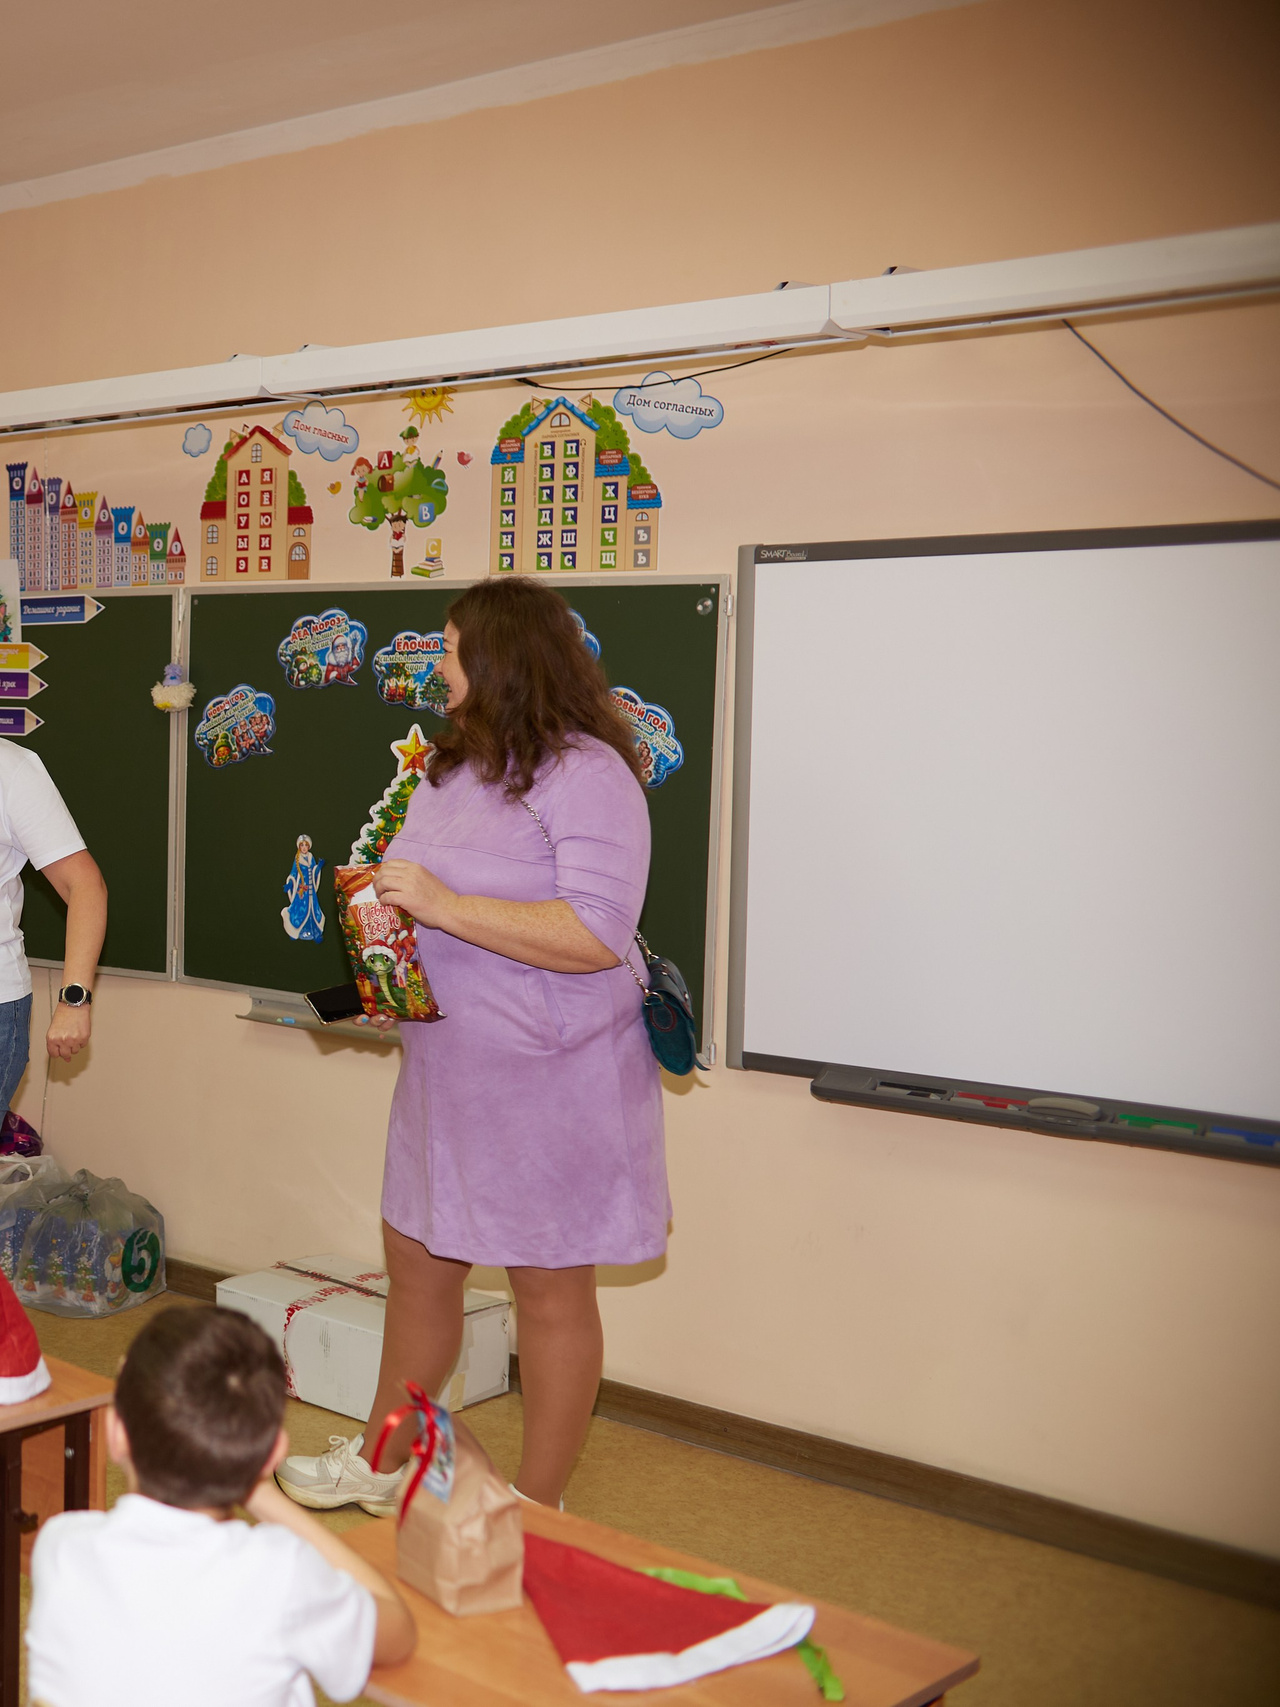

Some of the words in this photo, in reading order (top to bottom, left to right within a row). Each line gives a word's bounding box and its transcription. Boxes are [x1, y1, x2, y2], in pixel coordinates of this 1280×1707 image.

[626, 394, 651, 413] Дом
[653, 400, 714, 417] согласных
[292, 419, 312, 433] Дом
[311, 426, 349, 444] гласных
[542, 444, 552, 456] Б
[566, 442, 577, 455] П
[380, 454, 390, 468] A
[263, 471, 270, 482] Я
[504, 468, 514, 482] Й
[542, 466, 552, 479] В
[566, 464, 576, 478] Ф
[240, 472, 248, 484] А
[503, 490, 514, 502] Л
[542, 489, 551, 501] Г
[564, 488, 576, 500] К
[605, 485, 616, 498] Х
[240, 494, 248, 505] О
[262, 492, 270, 504] Ё
[422, 506, 430, 520] B
[502, 513, 514, 525] М
[540, 510, 551, 524] Д
[564, 510, 574, 522] Т
[604, 508, 616, 520] Ц
[239, 516, 248, 527] У
[260, 515, 271, 526] Ю
[502, 535, 512, 546] Н
[538, 532, 552, 545] Ж
[562, 532, 576, 544] Ш
[604, 530, 614, 542] Ч
[637, 530, 648, 542] Ъ
[238, 538, 248, 549] Ы
[261, 537, 270, 548] И
[428, 541, 438, 555] C
[564, 554, 573, 566] С
[637, 553, 646, 564] Ь
[760, 549, 787, 559] SMART
[238, 560, 246, 570] Э
[261, 559, 269, 570] Е
[502, 556, 511, 568] Р
[540, 555, 548, 567] З
[602, 554, 616, 567] Щ
[23, 605, 55, 616] Домашнее
[55, 604, 80, 617] задание
[290, 628, 310, 644] ДЕД
[396, 637, 440, 651] ЁЛОЧКА
[406, 652, 444, 665] новогодн
[230, 692, 246, 706] ГОД
[646, 710, 668, 732] ГОД
[633, 727, 654, 744] ародов
